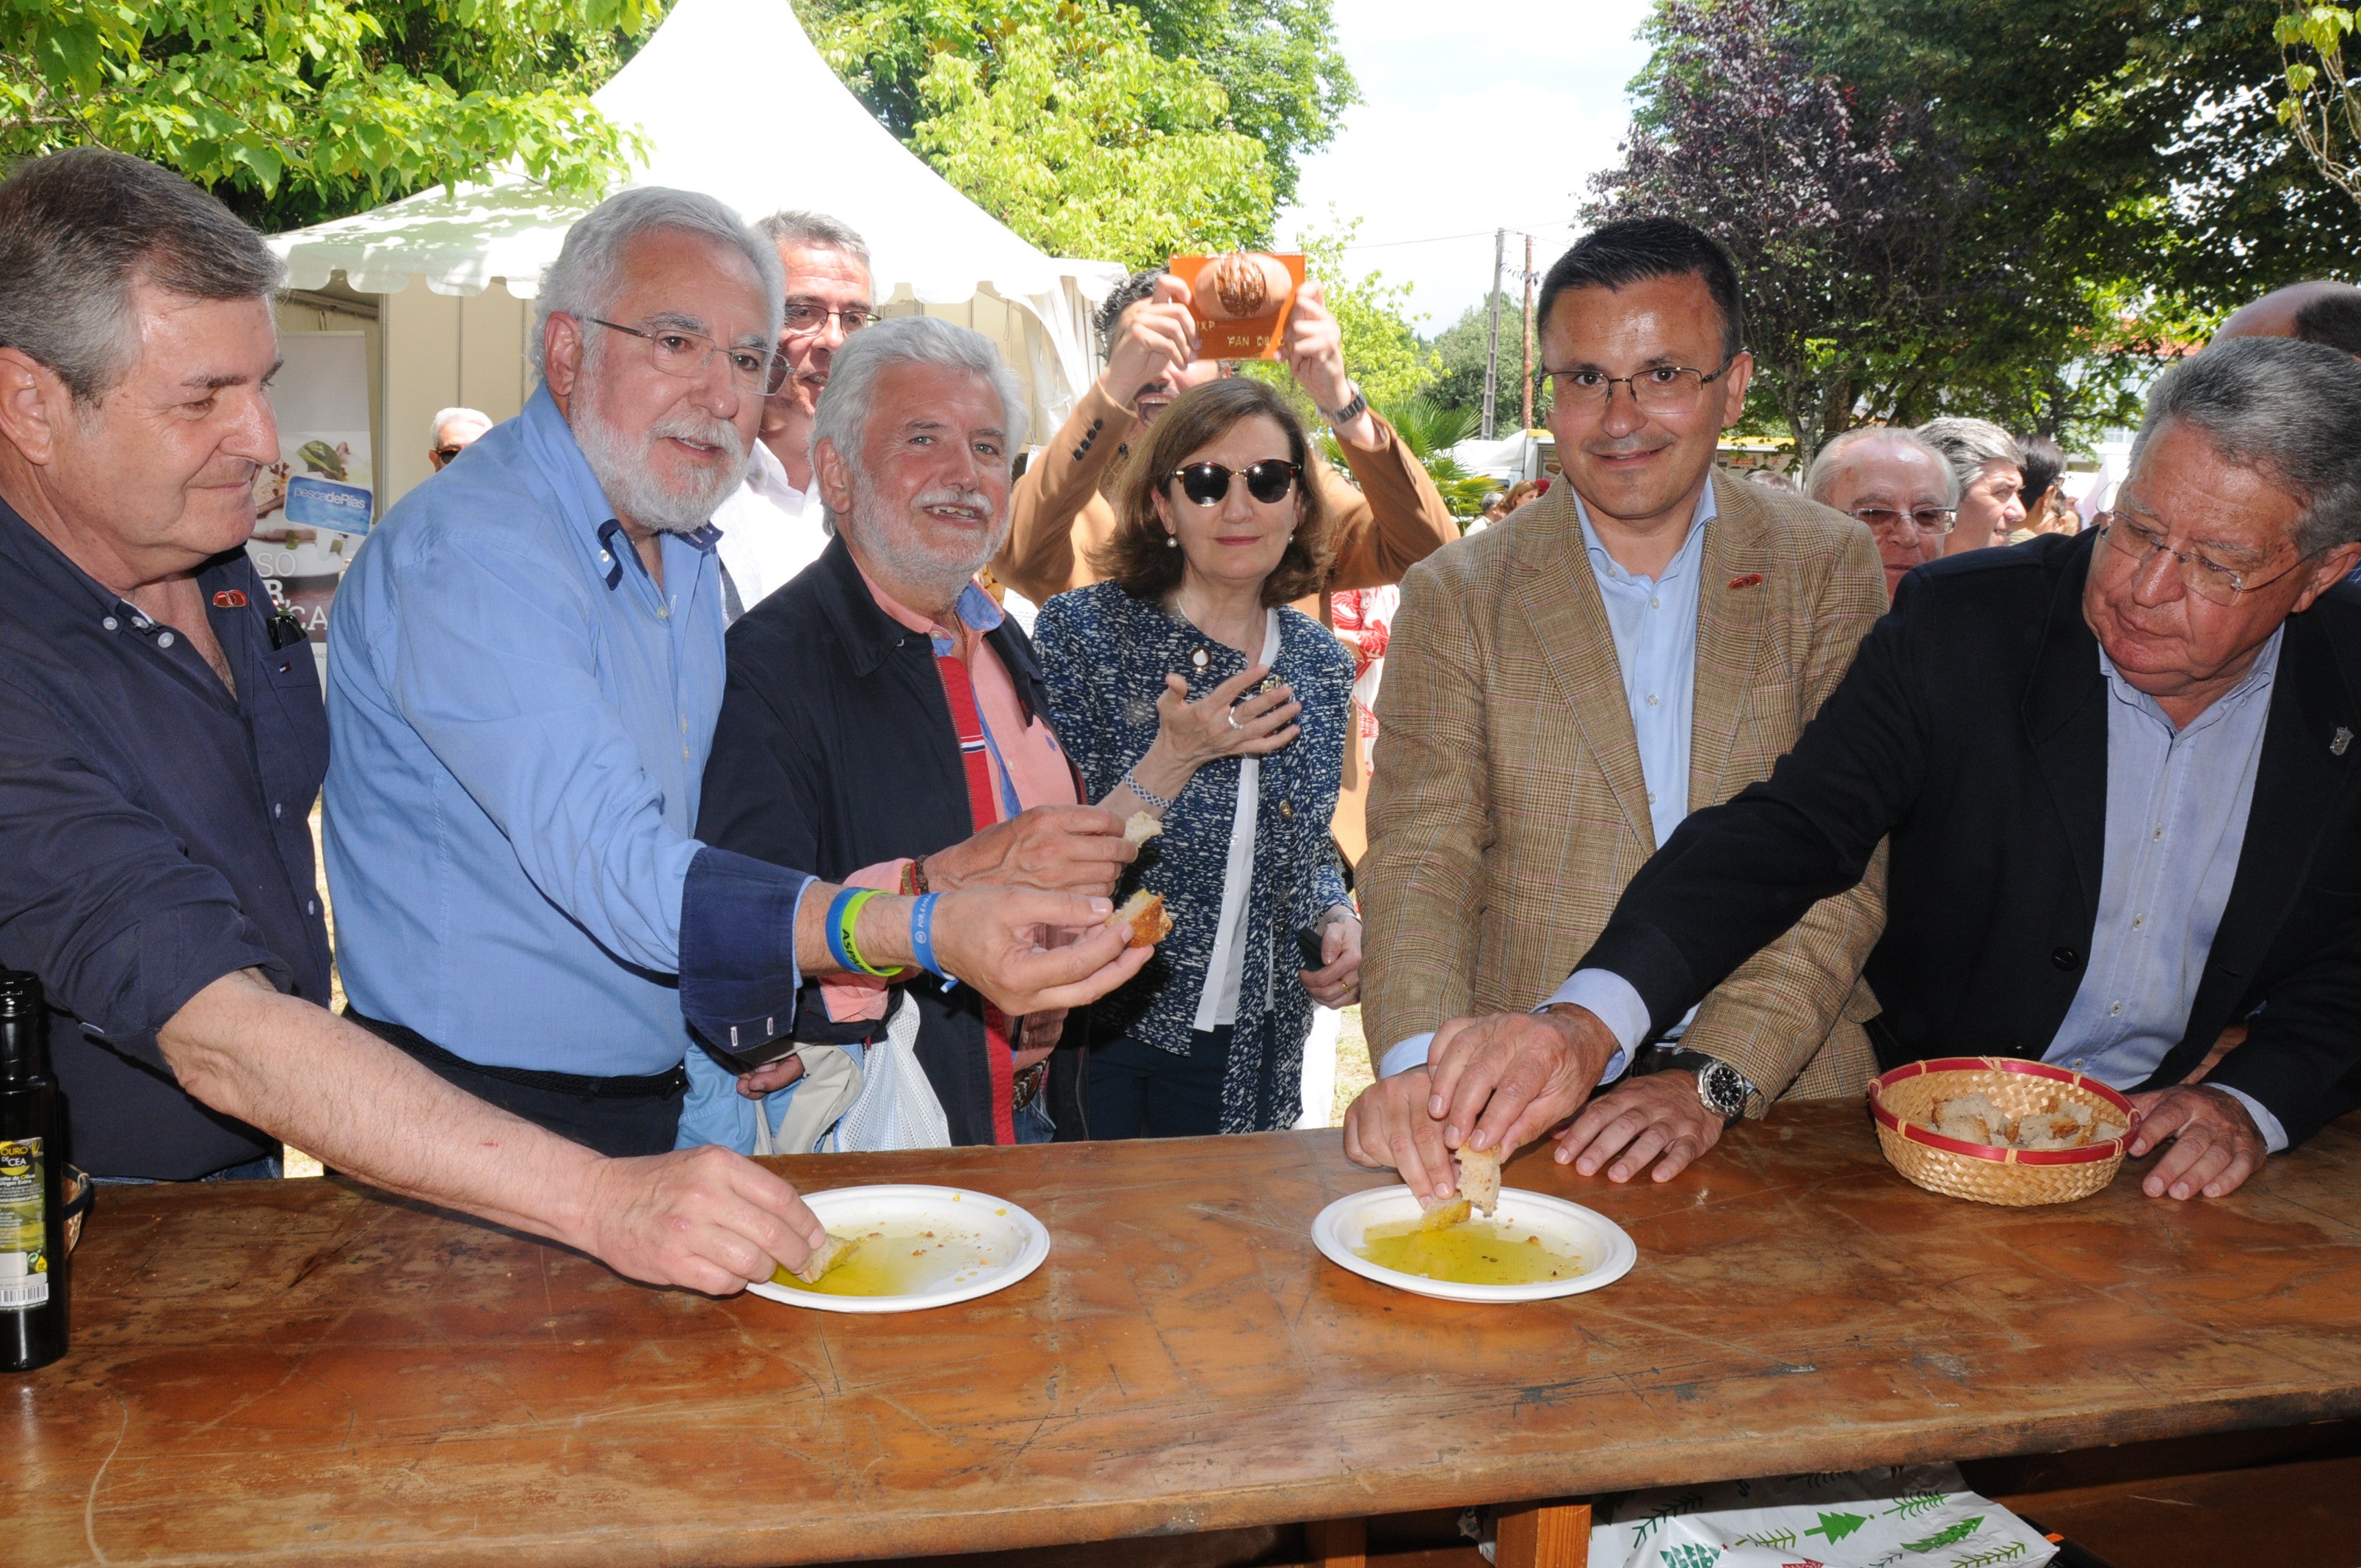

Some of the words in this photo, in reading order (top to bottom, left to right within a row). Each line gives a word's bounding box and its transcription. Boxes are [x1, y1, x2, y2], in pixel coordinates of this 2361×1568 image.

[1227, 335, 1250, 346] PAN
[294, 487, 366, 509] pescadeRías
[255, 552, 296, 577] SO
[261, 579, 291, 609] R,
[1, 1146, 29, 1155] OURO
[8, 1157, 27, 1166] CEA
